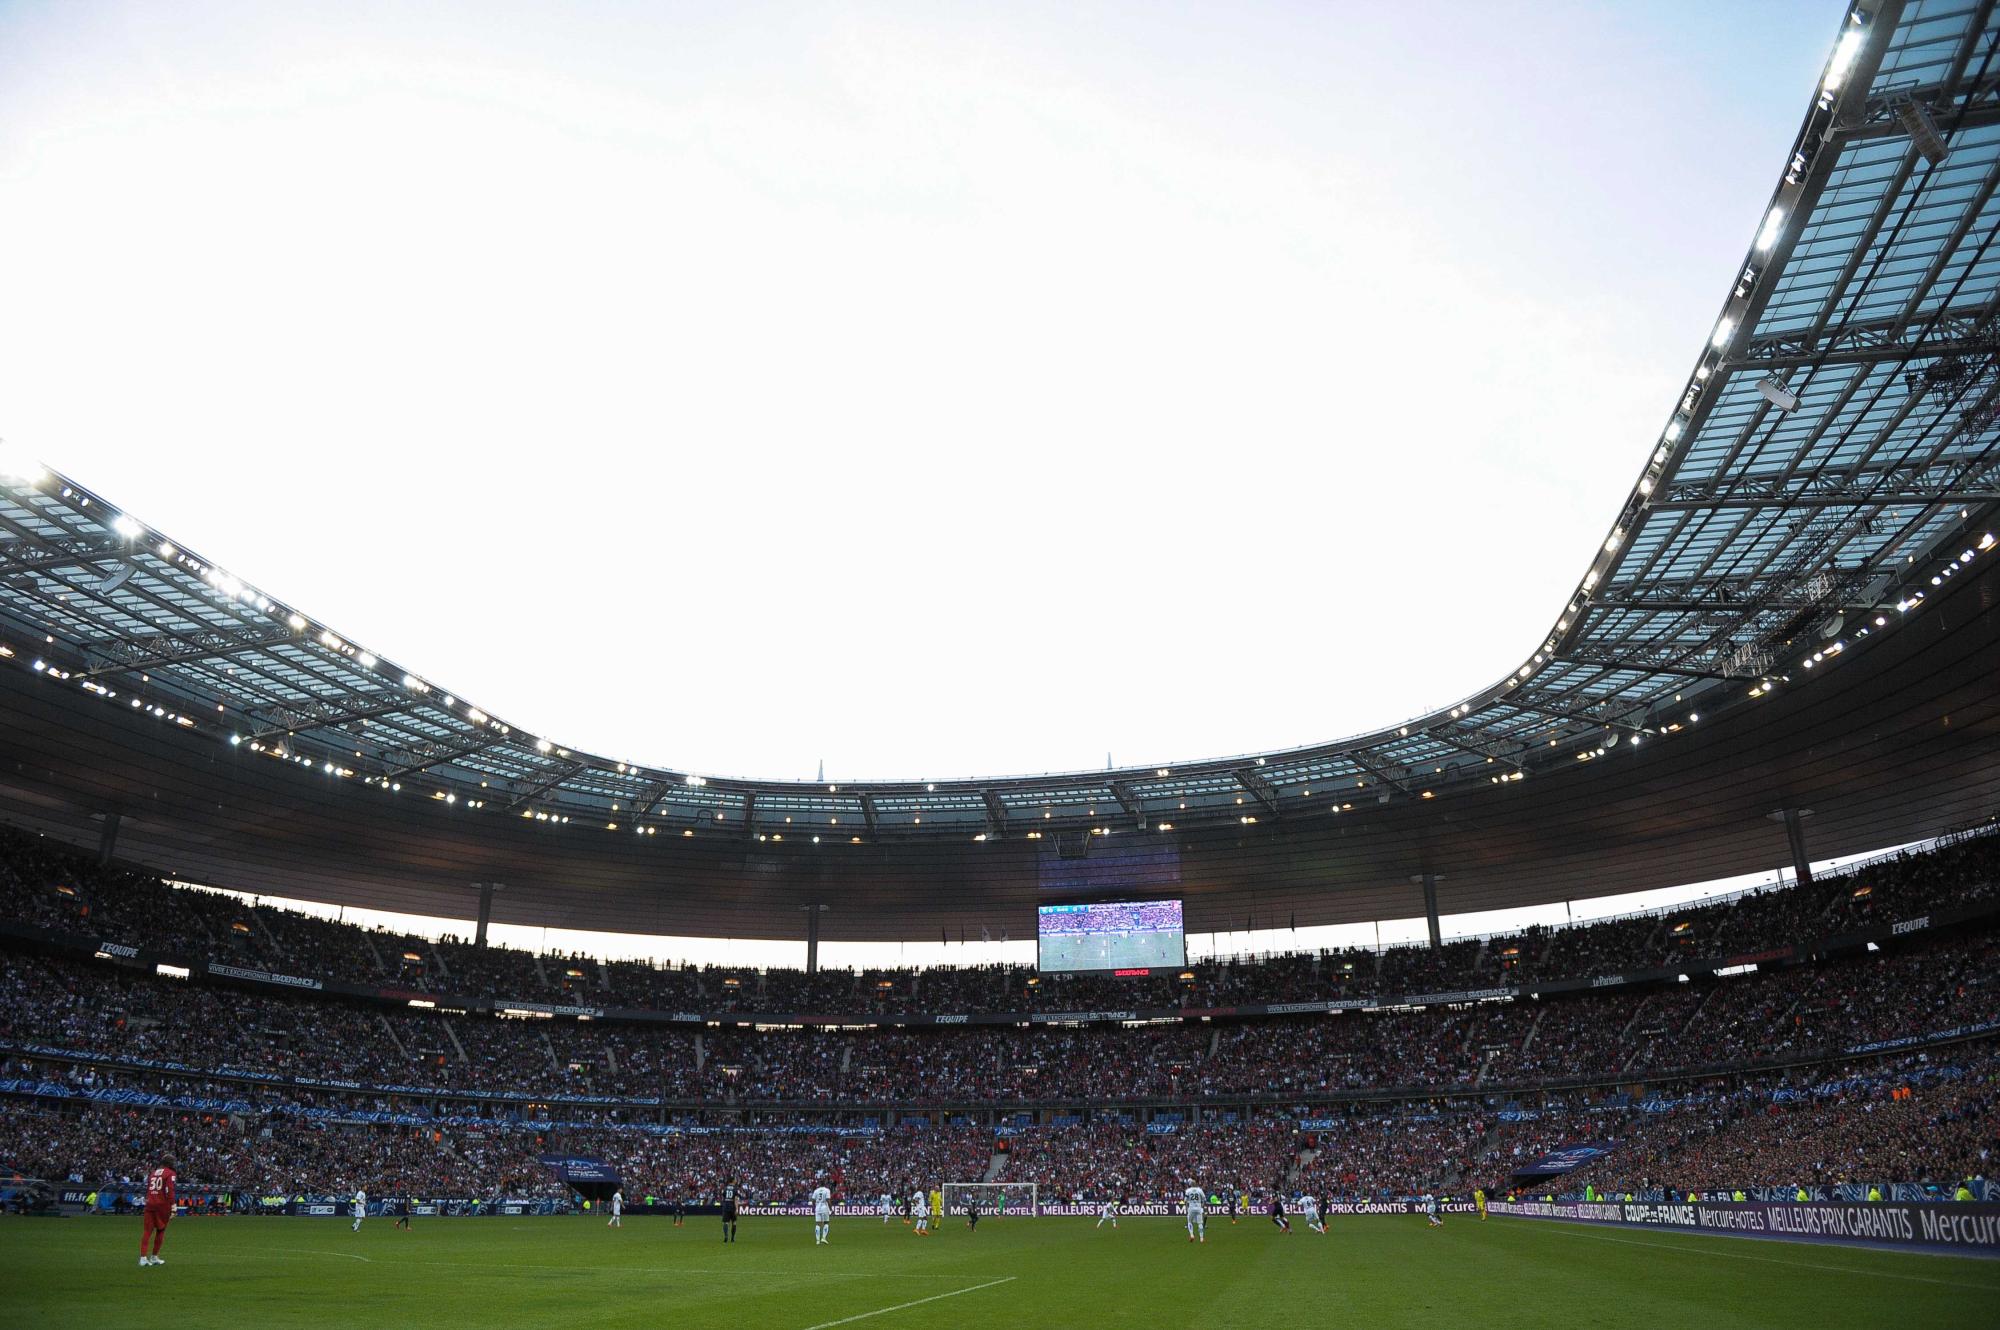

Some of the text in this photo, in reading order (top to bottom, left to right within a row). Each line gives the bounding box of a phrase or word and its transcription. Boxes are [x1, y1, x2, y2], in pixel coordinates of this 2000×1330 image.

[149, 1177, 163, 1191] 30
[726, 1190, 734, 1199] 10
[740, 1205, 787, 1216] Mercure
[788, 1207, 816, 1216] HOTEL
[1043, 1205, 1095, 1216] MEILLEURS
[1120, 1204, 1168, 1215] GARANTIS
[1332, 1203, 1352, 1214] PRIX
[1355, 1203, 1407, 1214] GARANTIS
[1657, 1205, 1696, 1225] FRANCE
[1698, 1206, 1735, 1229] Mercure
[1735, 1210, 1765, 1230] HOTELS
[1767, 1207, 1821, 1234] MEILLEURS
[1822, 1207, 1849, 1235] PRIX
[1849, 1207, 1913, 1240] GARANTIS
